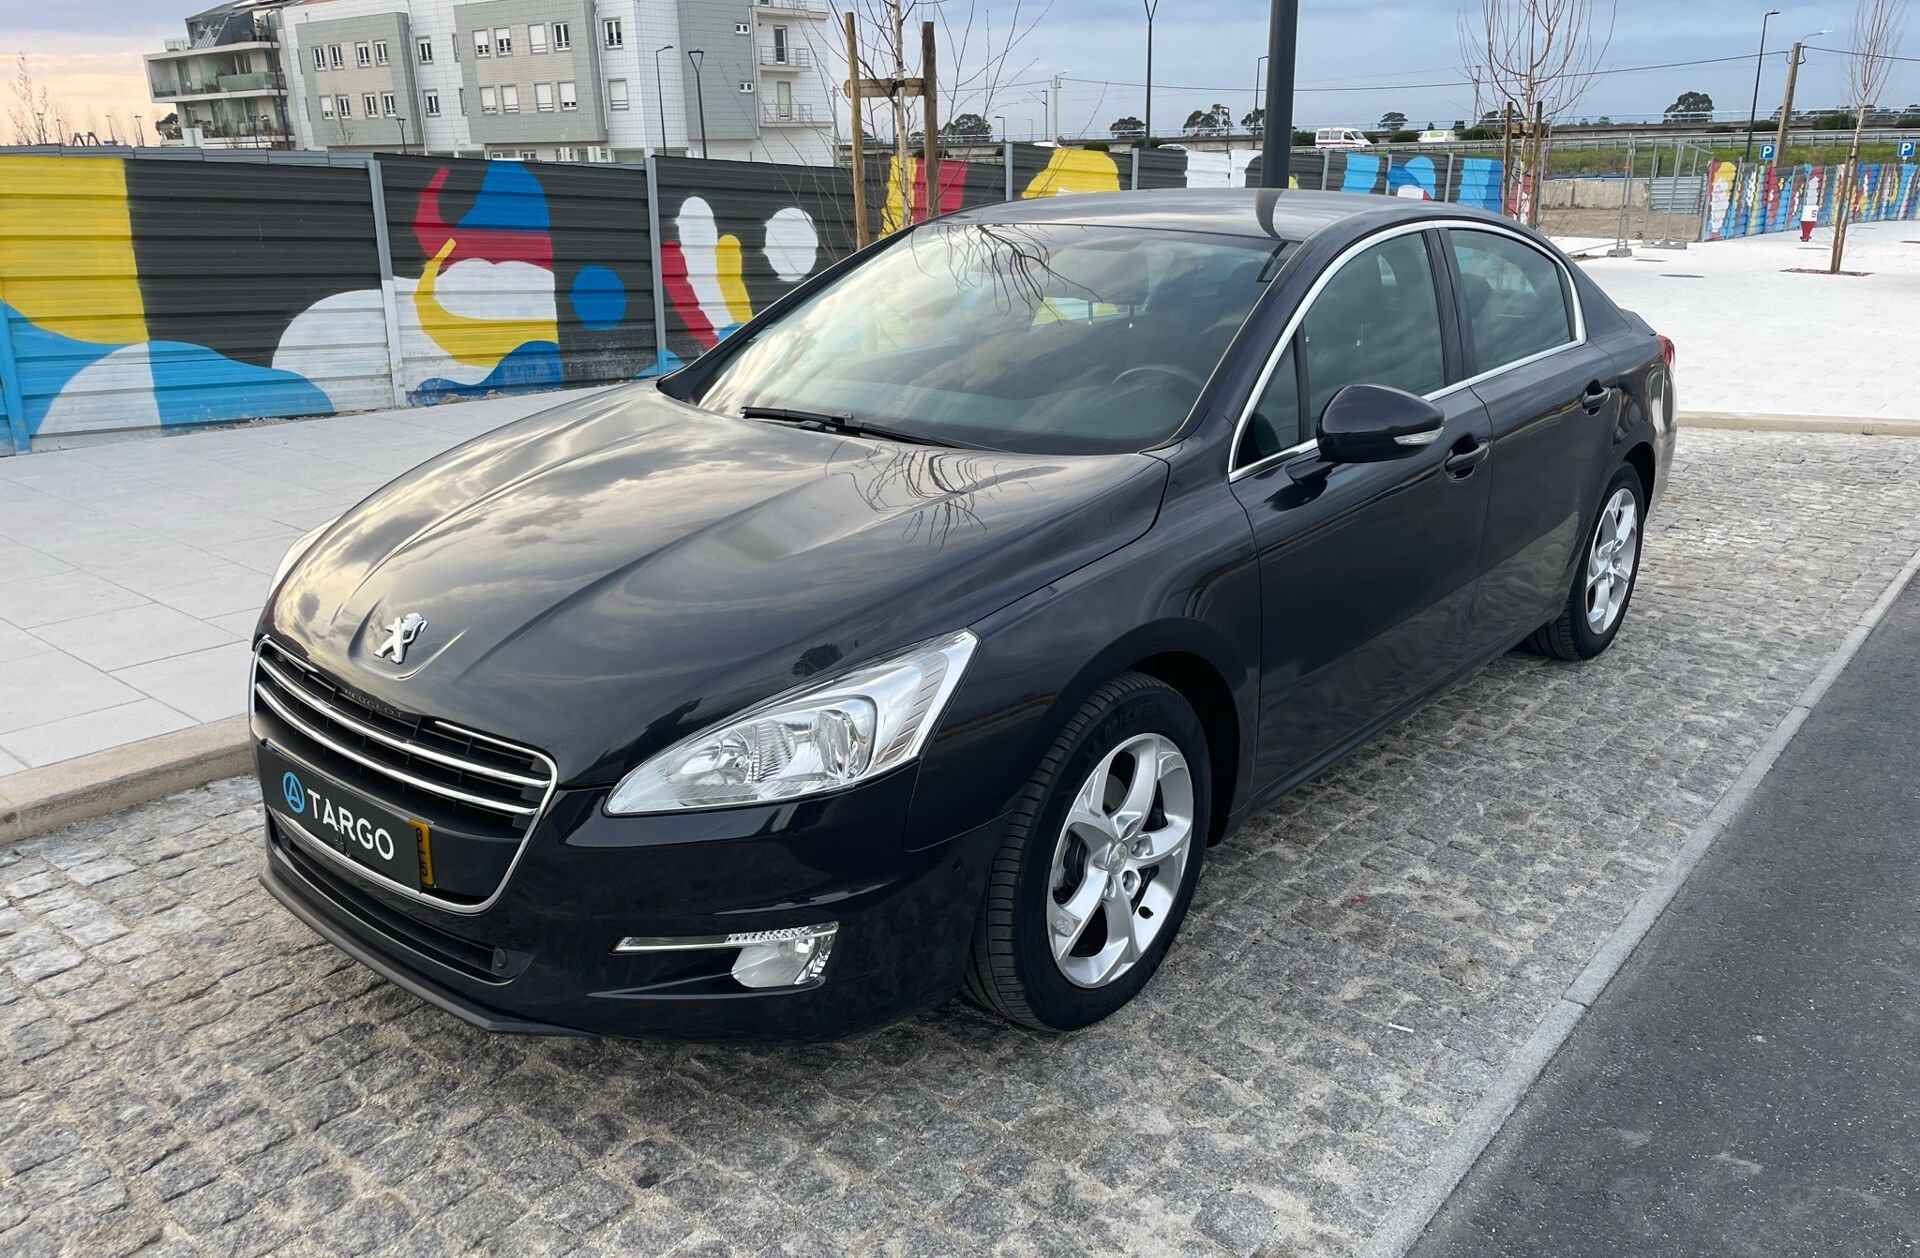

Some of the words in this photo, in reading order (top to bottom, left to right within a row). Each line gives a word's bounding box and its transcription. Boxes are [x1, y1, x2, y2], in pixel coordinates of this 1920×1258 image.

[1762, 146, 1772, 158] P
[1900, 143, 1912, 155] P
[307, 788, 395, 861] TARGO
